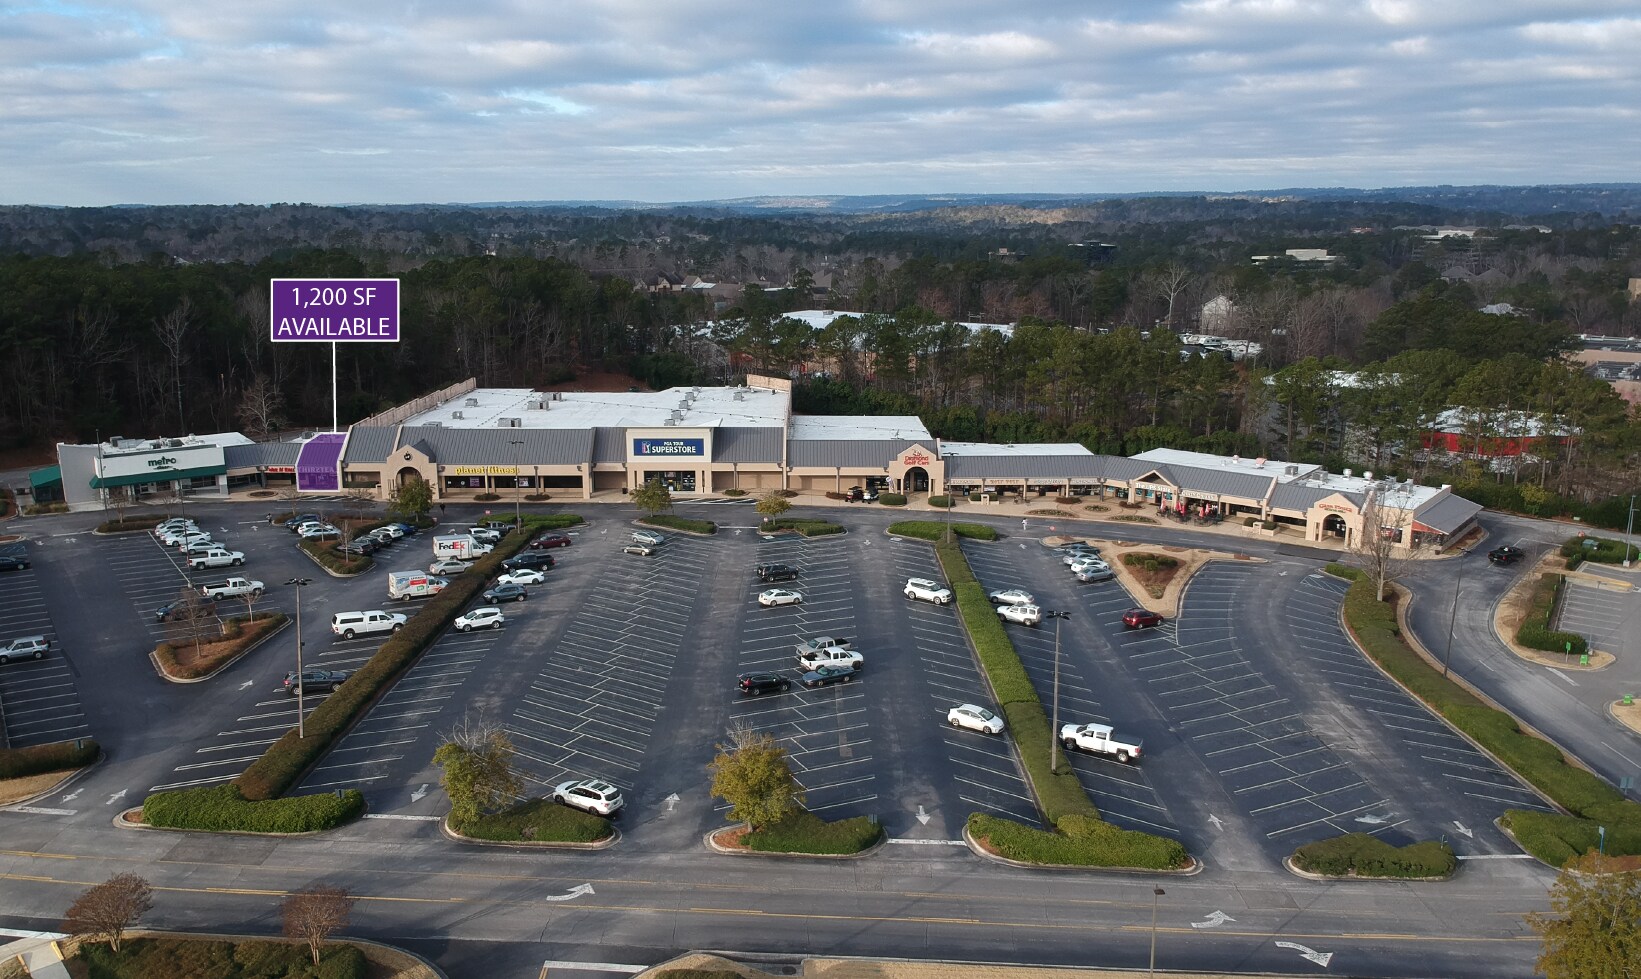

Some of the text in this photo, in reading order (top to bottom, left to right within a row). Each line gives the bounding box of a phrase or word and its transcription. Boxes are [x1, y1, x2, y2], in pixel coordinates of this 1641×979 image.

[147, 456, 177, 467] metro
[455, 466, 485, 475] planet
[438, 541, 465, 550] FedEx
